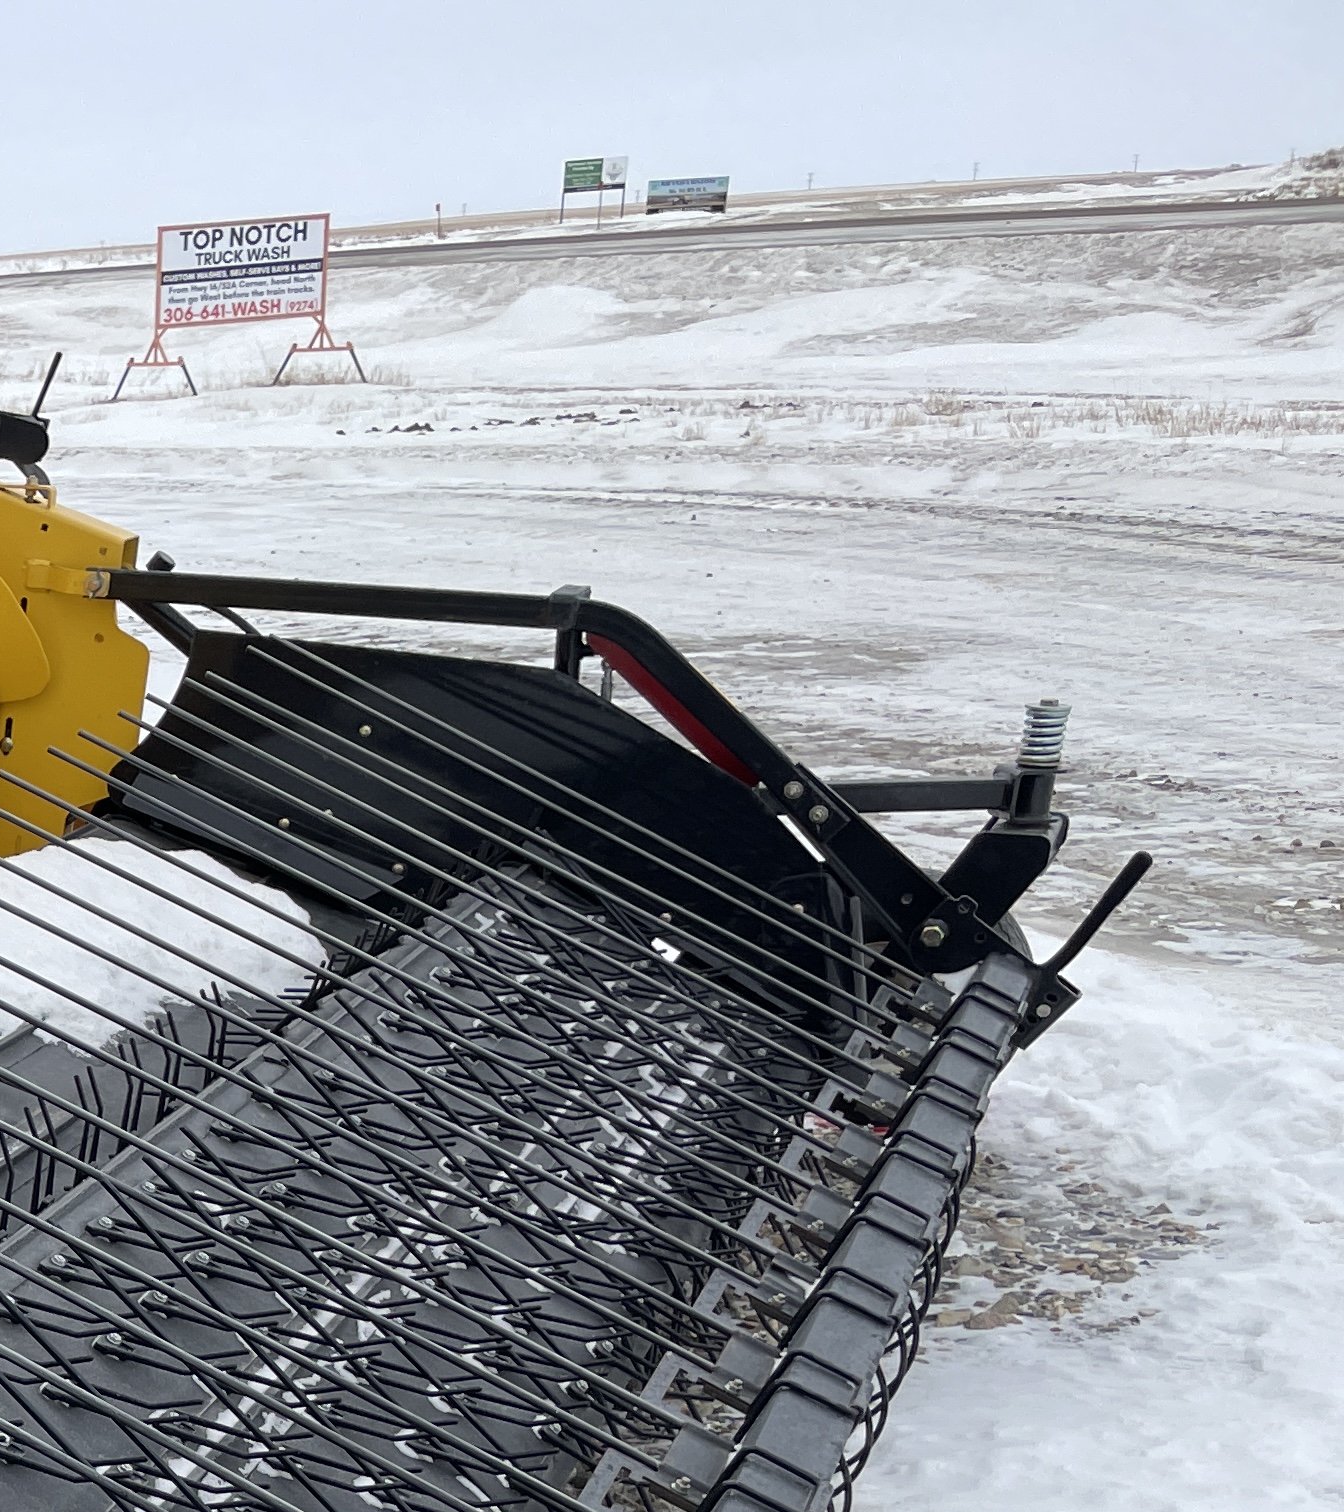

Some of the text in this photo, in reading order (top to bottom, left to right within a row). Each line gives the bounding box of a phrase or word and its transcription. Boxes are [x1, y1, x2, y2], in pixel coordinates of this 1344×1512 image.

[179, 221, 308, 251] TOP NOTCH
[195, 245, 290, 266] TRUCK WASH
[163, 297, 318, 323] 306-641-WASH (9274)
